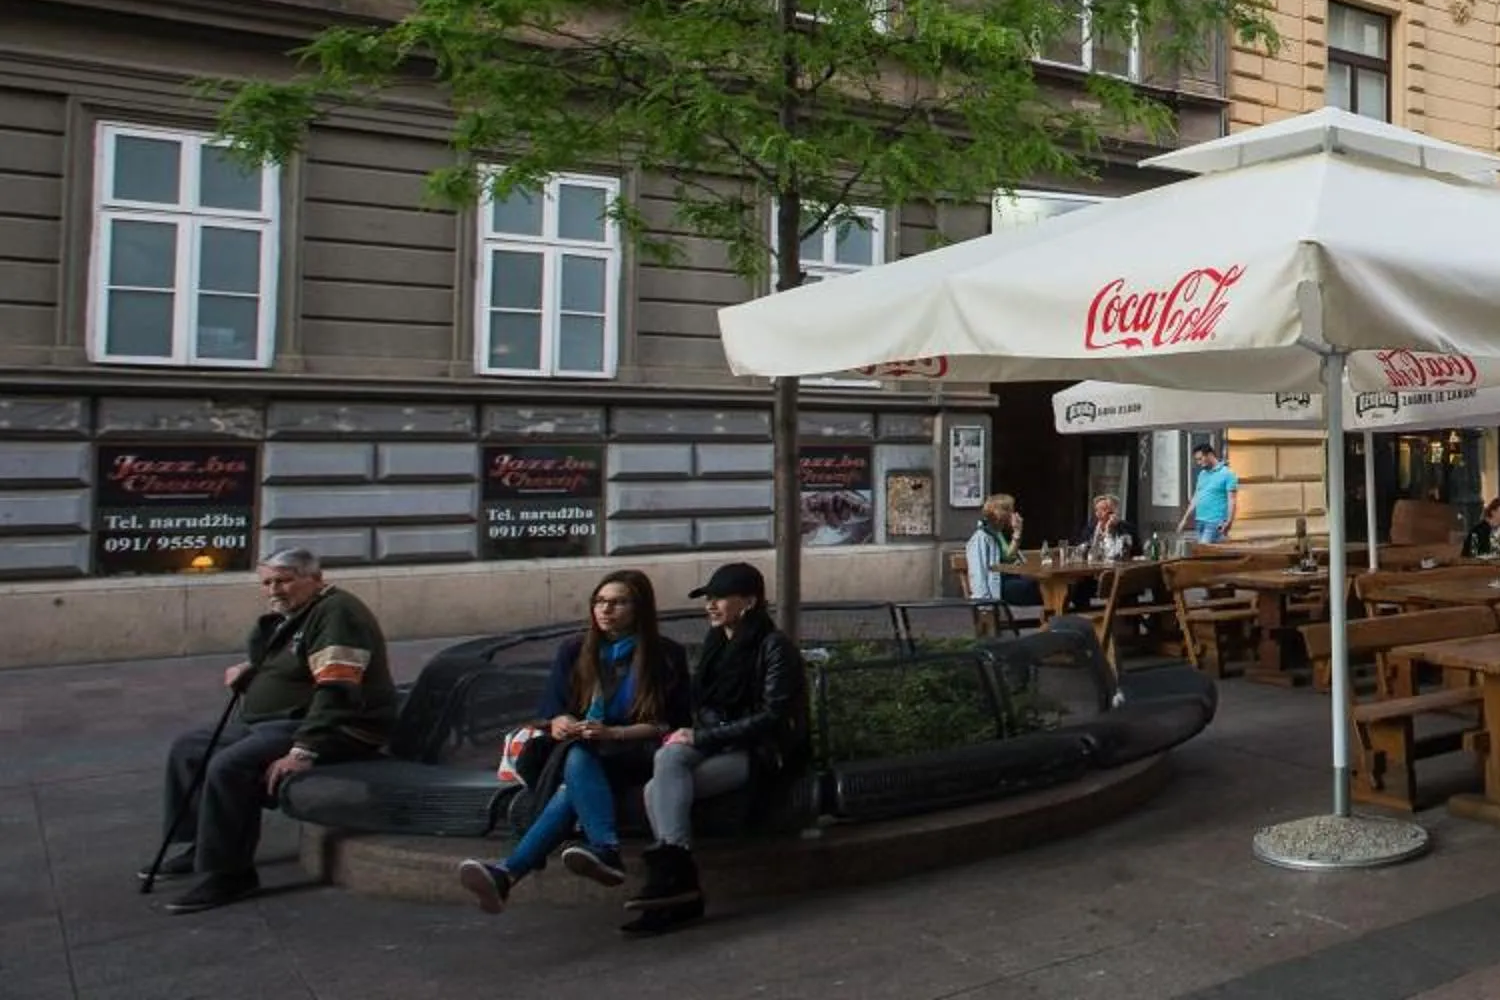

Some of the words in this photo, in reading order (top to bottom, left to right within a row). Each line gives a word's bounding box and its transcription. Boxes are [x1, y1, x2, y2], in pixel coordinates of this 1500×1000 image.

[103, 514, 144, 530] Tel.
[487, 508, 516, 521] Tel.
[488, 525, 526, 538] 091/
[528, 523, 568, 537] 9555
[569, 522, 597, 536] 001
[104, 536, 152, 552] 091/
[156, 535, 208, 550] 9555
[212, 534, 247, 549] 001
